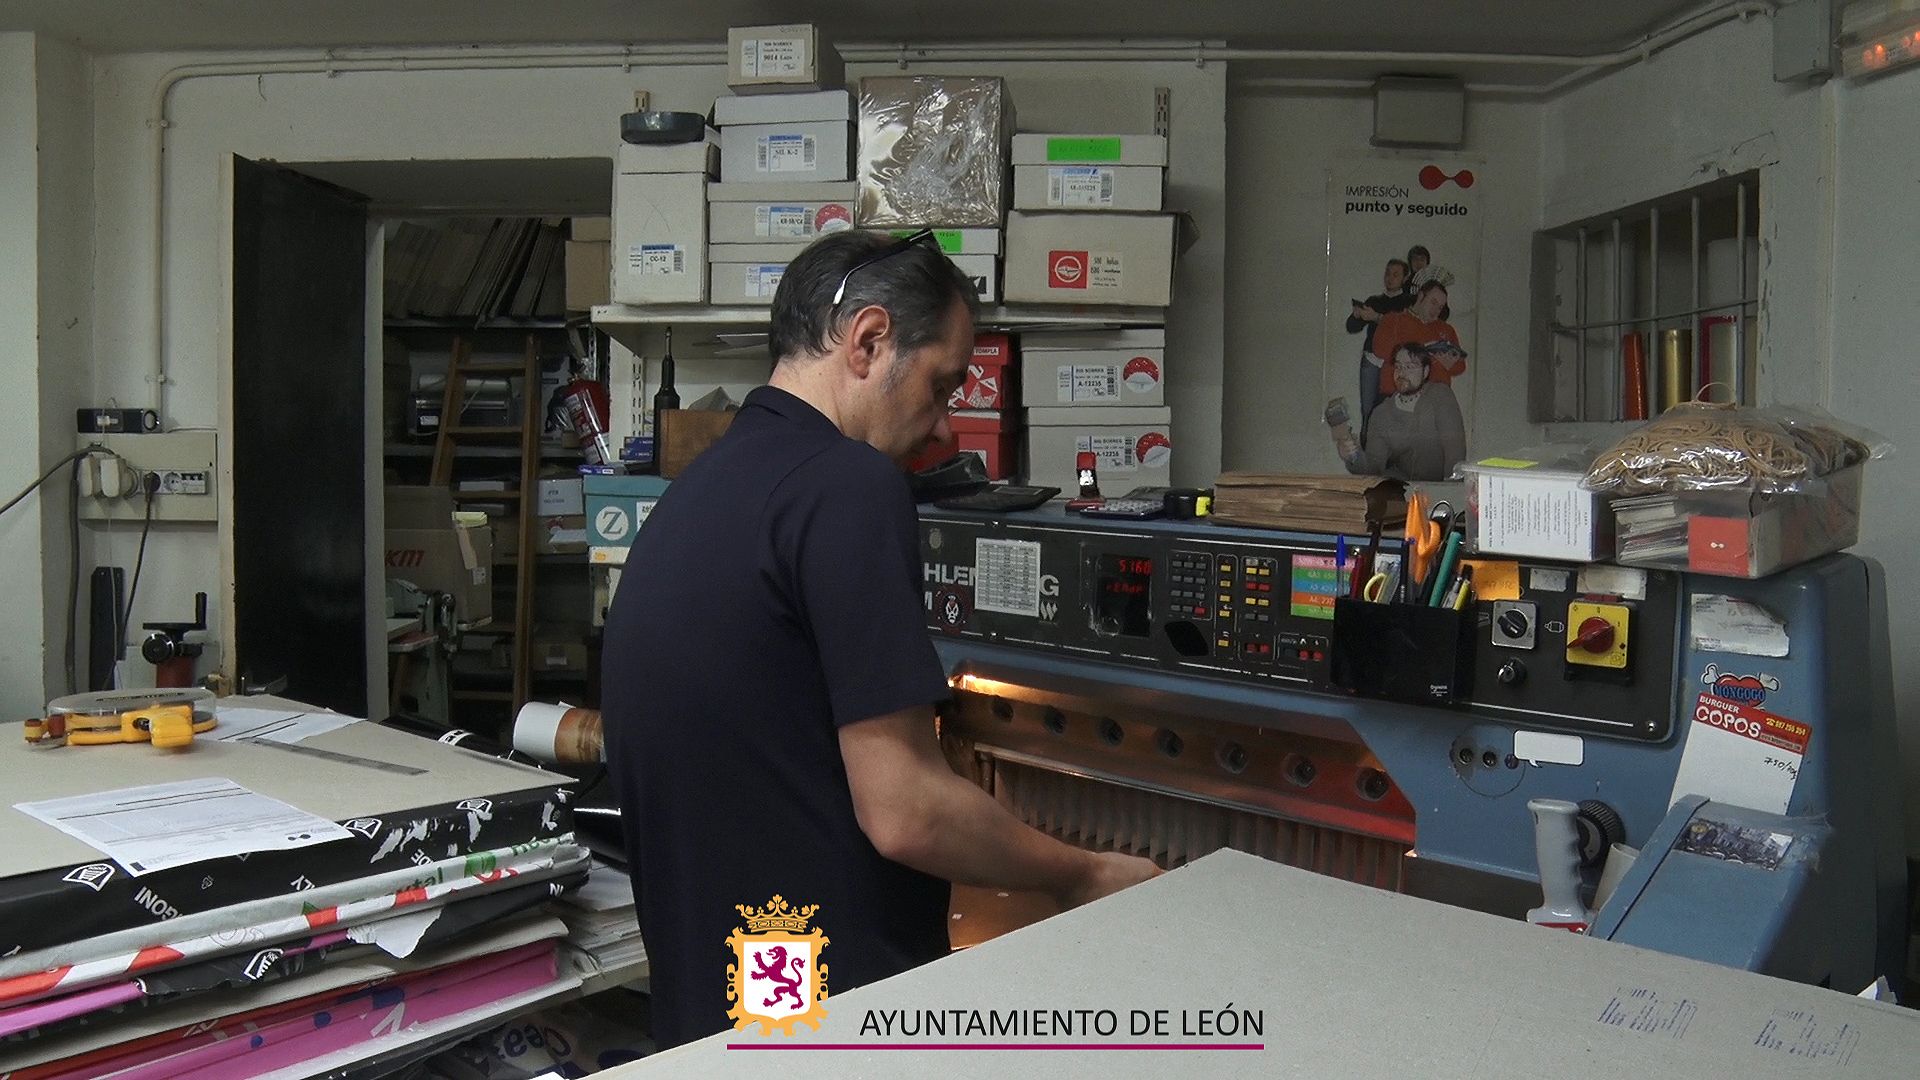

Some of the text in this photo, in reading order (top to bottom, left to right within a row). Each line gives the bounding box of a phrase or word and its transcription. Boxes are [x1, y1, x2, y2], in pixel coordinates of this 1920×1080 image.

[1345, 184, 1409, 198] IMPRESIÓN
[1345, 201, 1468, 217] punto y seguido
[602, 511, 622, 534] Z
[1699, 695, 1741, 714] BURGUER
[1695, 705, 1761, 738] COPOS
